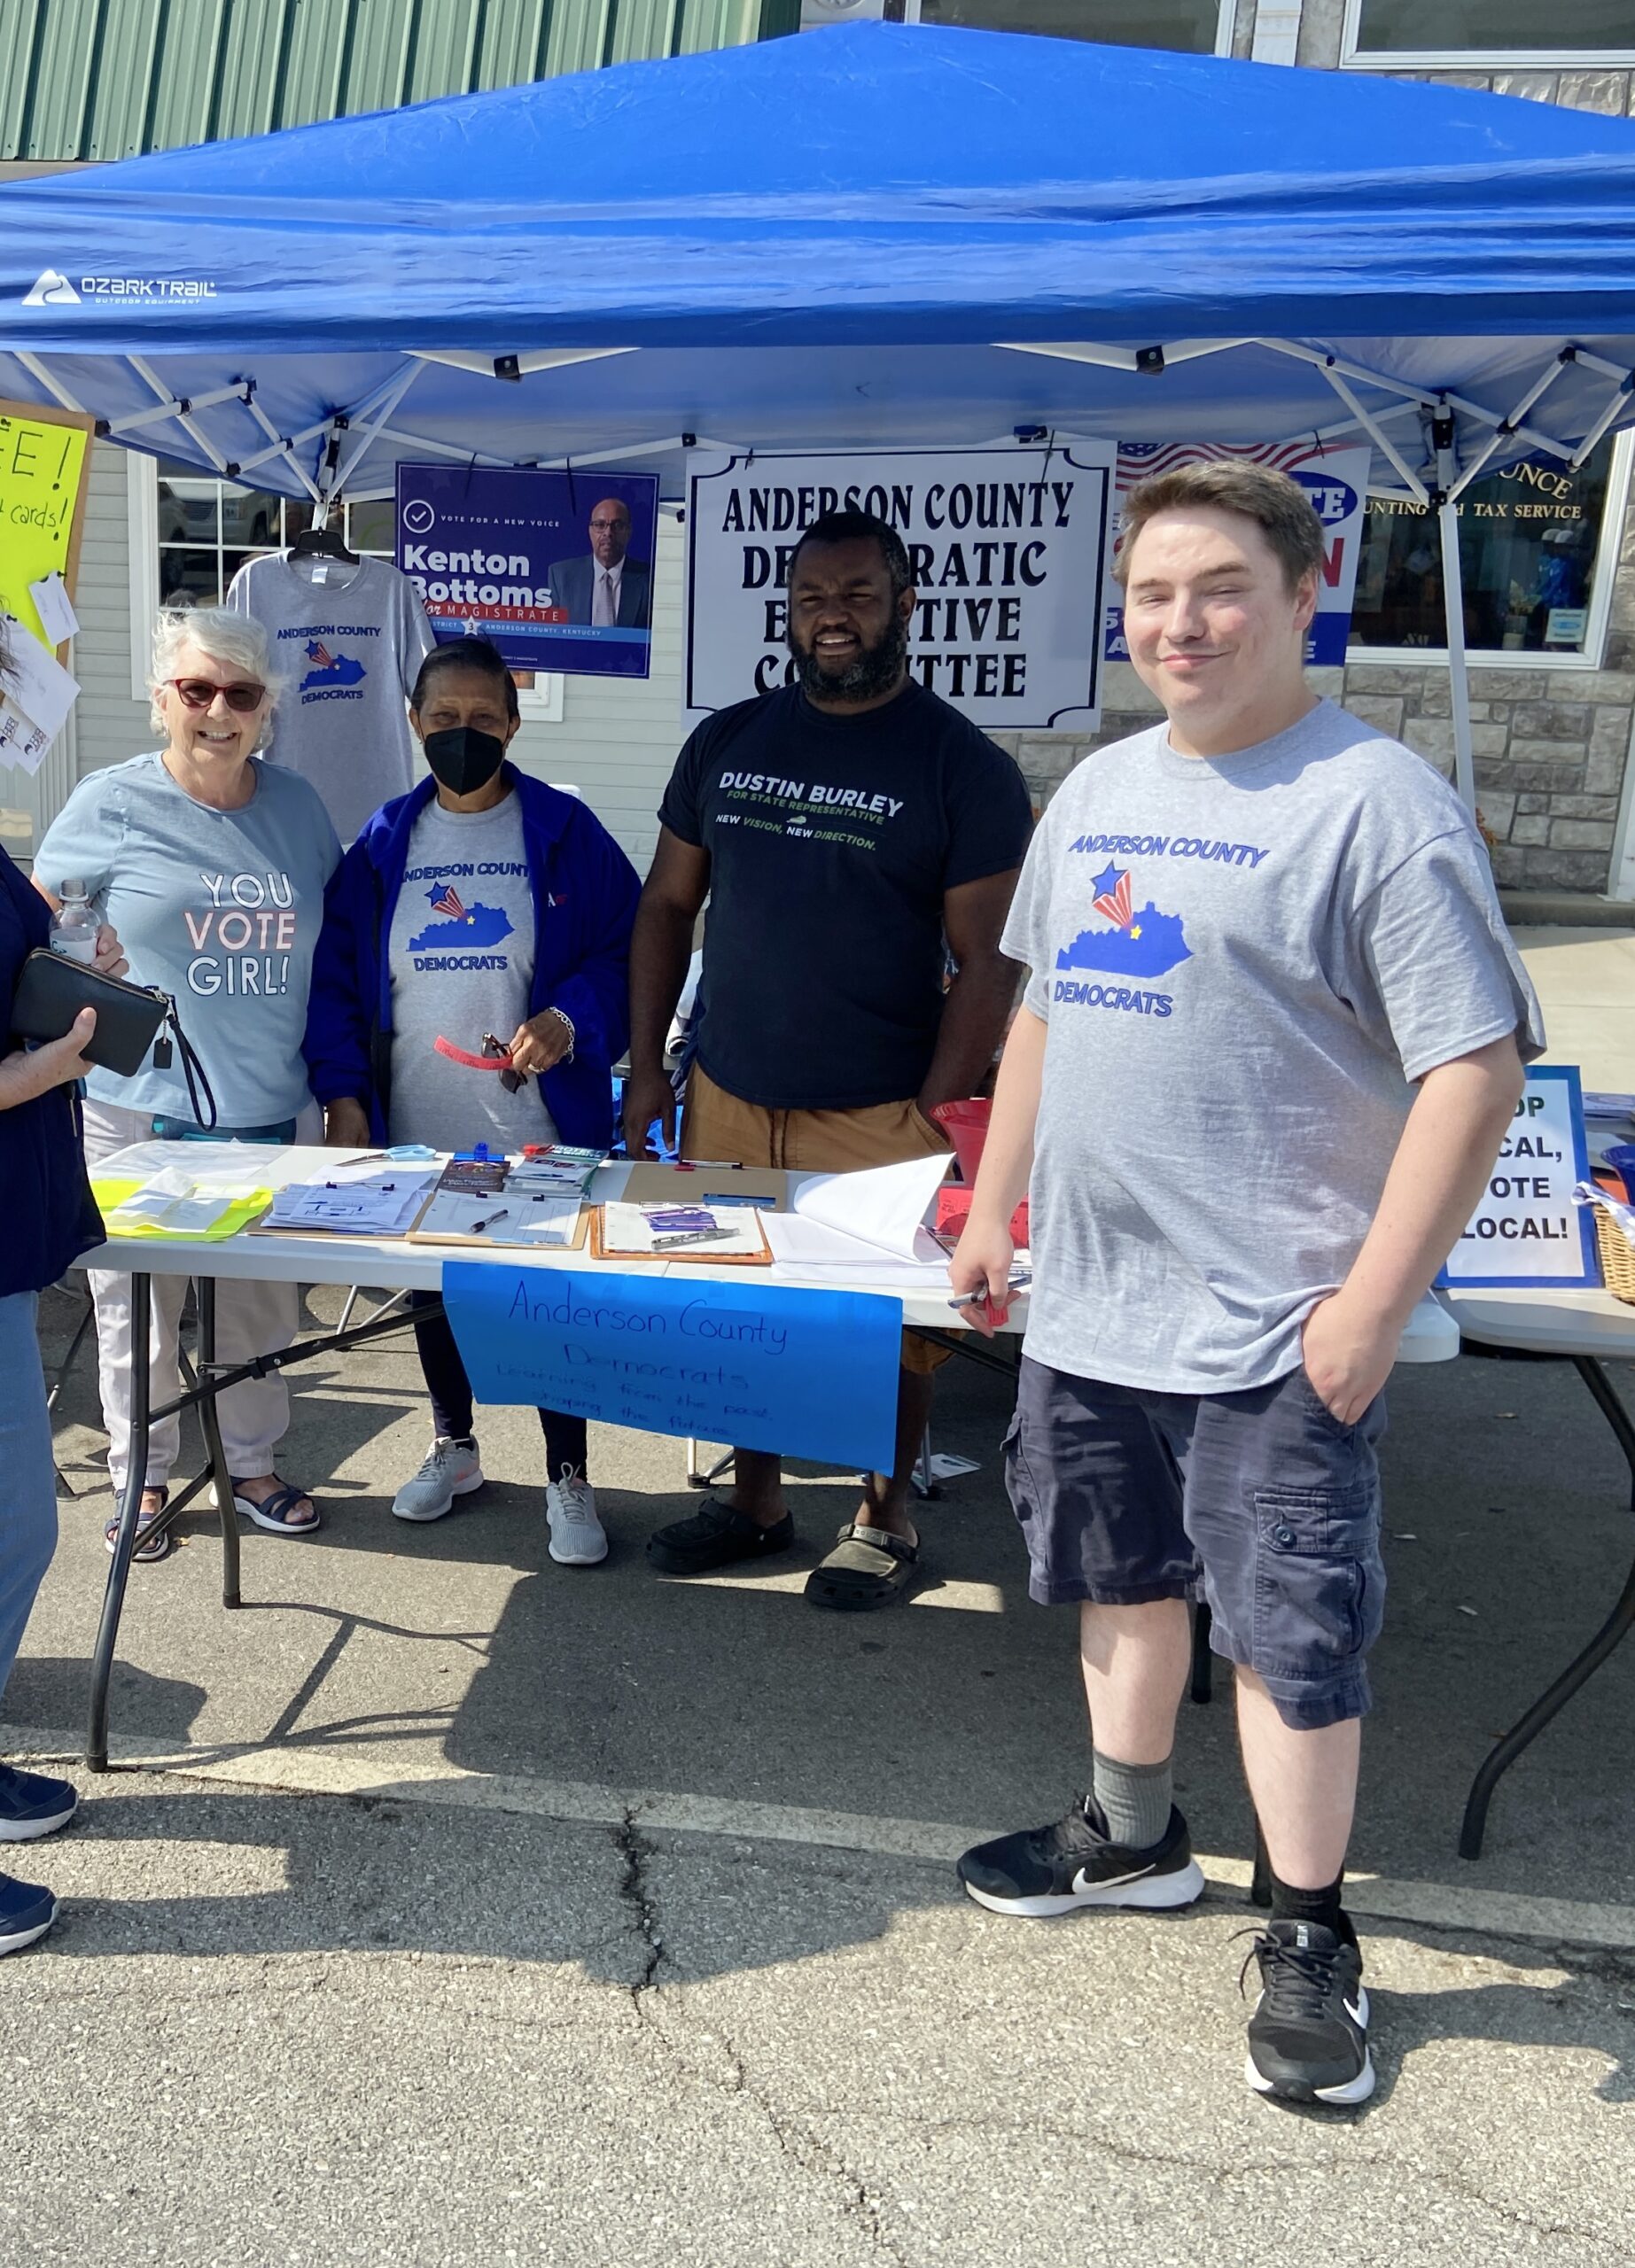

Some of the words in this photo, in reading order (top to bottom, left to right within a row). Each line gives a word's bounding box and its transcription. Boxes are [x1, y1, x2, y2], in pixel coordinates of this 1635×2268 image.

[82, 277, 154, 296] OZARK
[156, 280, 218, 298] TRAIL
[1499, 462, 1574, 501] UNCE
[722, 485, 913, 532] ANDERSON
[924, 482, 1074, 531] COUNTY
[1304, 487, 1345, 519] TE
[1364, 501, 1427, 515] UNTING
[1473, 503, 1507, 517] TAX
[1514, 505, 1582, 519] SERVICE
[404, 544, 530, 577] Kenton
[742, 540, 1047, 590] DERATIC
[409, 574, 553, 609] Bottoms
[432, 620, 457, 629] STRICT
[468, 622, 474, 631] 3
[486, 624, 526, 633] ANDERSON
[563, 628, 602, 637] KENTUCKY
[448, 605, 560, 622] MAGISTRATE
[764, 597, 1021, 643] ETIVE
[277, 625, 335, 640] ANDERSON
[337, 625, 381, 638] COUNTY
[301, 689, 363, 705] DEMOCRATS
[719, 772, 805, 799] DUSTIN
[808, 785, 904, 818] BURLEY
[727, 789, 748, 799] FOR
[750, 793, 786, 808] STATE
[788, 801, 885, 825] REPRESENTATIVE
[715, 813, 740, 824] NEW
[744, 817, 783, 835] VISION,
[786, 825, 813, 838] NEW
[814, 830, 876, 850] DIRECTION.
[1068, 835, 1170, 856] ANDERSON
[1170, 836, 1271, 869] COUNTY
[404, 863, 474, 882] NDERSON
[477, 862, 529, 877] COUNT
[199, 872, 294, 910] YOU
[183, 911, 297, 951] VOTE
[187, 955, 290, 997] GIRL!
[414, 955, 508, 972] DEMOCRATS
[1054, 981, 1173, 1017] DEMOCRATS
[1498, 1136, 1562, 1163] CAL,
[1490, 1177, 1551, 1199] OTE
[509, 1279, 666, 1333] Anderson
[679, 1298, 788, 1355] County
[564, 1343, 751, 1390] Democrats
